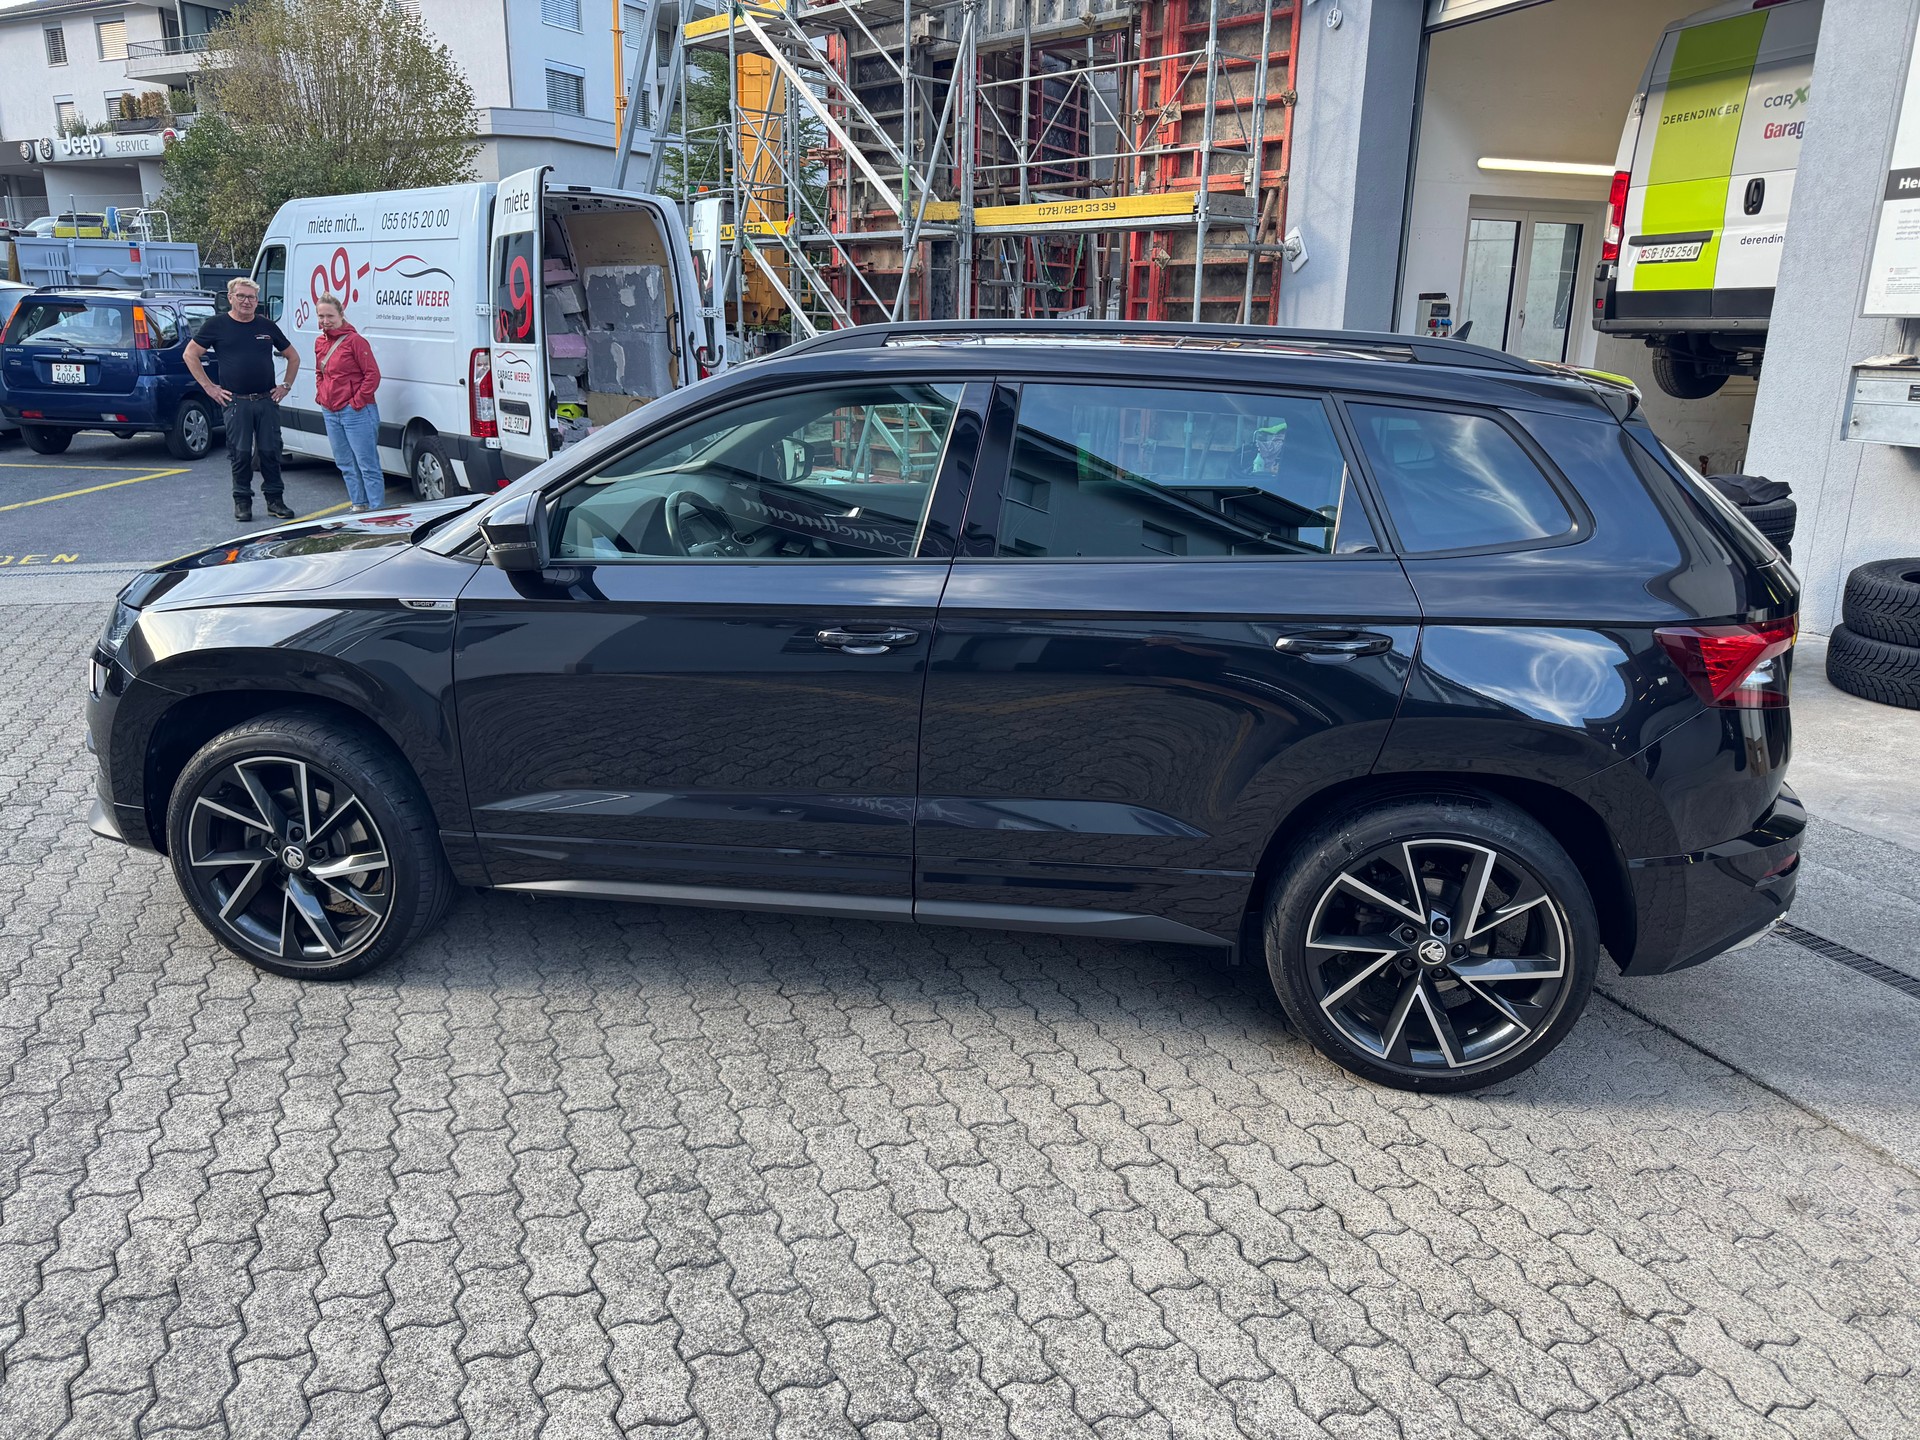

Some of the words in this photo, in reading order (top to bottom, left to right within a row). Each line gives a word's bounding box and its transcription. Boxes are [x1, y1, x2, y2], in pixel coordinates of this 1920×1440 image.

[1663, 104, 1740, 125] DERENDINGER
[62, 131, 101, 158] Jeep
[116, 139, 149, 152] SERVICE
[504, 189, 530, 215] miete
[307, 216, 333, 234] miete
[334, 213, 365, 233] mich...
[381, 212, 399, 230] 055
[400, 211, 419, 230] 615
[420, 210, 434, 228] 20
[436, 208, 449, 227] 00
[1740, 233, 1785, 245] derendin
[376, 289, 413, 306] GARAGE
[416, 290, 450, 307] WEBER
[509, 255, 532, 338] 9
[295, 298, 310, 329] ab
[56, 373, 81, 382] 40065
[497, 369, 513, 381] GARAGE
[514, 371, 531, 383] WEBER
